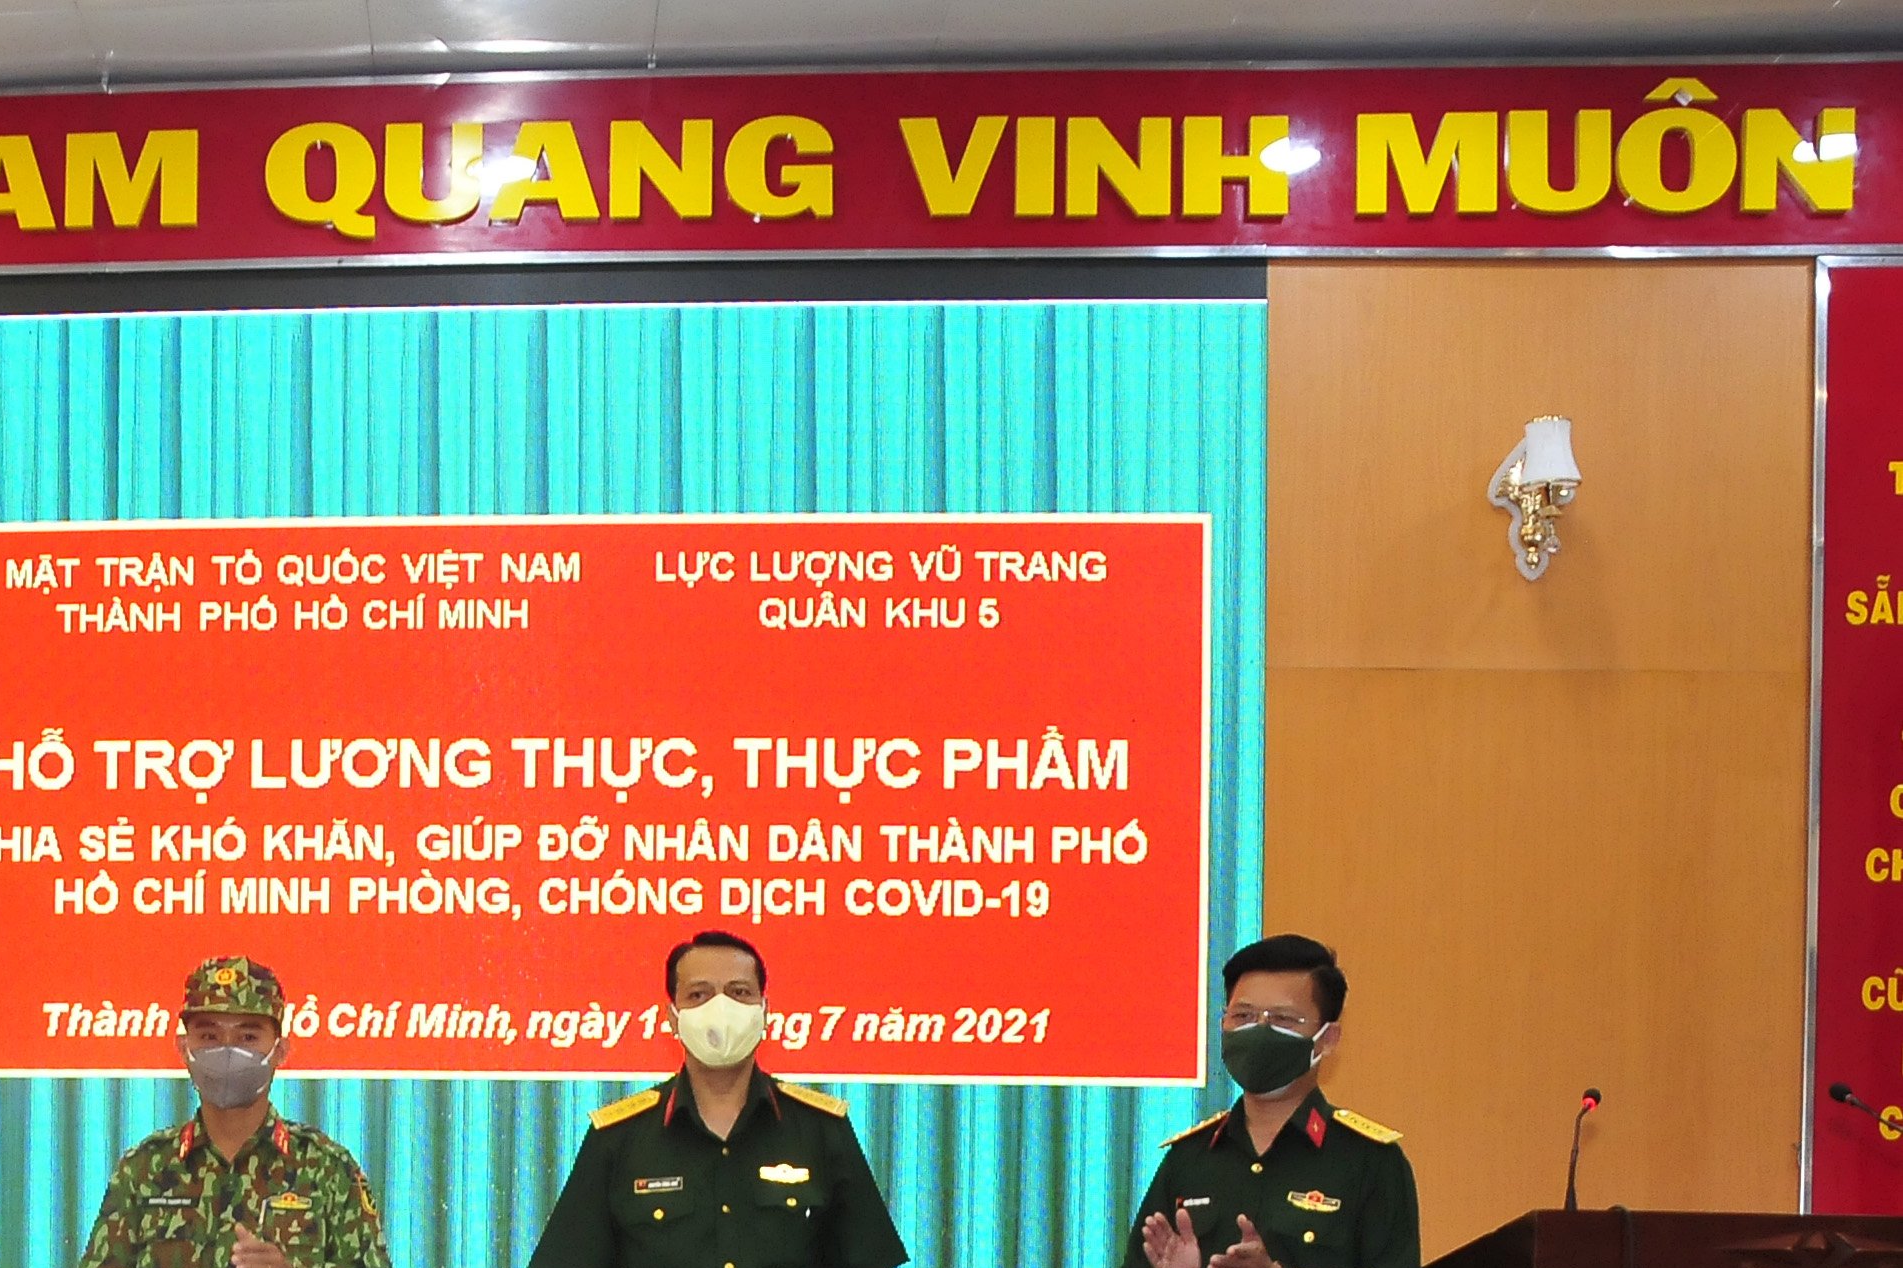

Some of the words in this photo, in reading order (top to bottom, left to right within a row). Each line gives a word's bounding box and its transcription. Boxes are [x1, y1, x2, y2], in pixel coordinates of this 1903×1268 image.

[264, 113, 835, 241] QUANG
[900, 113, 1293, 219] VINH
[1354, 76, 1856, 216] MUÔN
[6, 555, 80, 594] MẶT
[96, 553, 194, 592] TRẬN
[212, 549, 262, 585] TỔ
[277, 548, 385, 586] QUỐC
[402, 549, 483, 589] VIỆT
[502, 552, 580, 582] NAM
[656, 552, 734, 588] LỰC
[751, 551, 893, 587] LƯỢNG
[910, 545, 961, 581] VŨ
[975, 551, 1106, 581] TRANG
[56, 597, 180, 633] THÀNH
[200, 595, 277, 631] PHỐ
[295, 594, 347, 630] HỒ
[363, 593, 425, 629] CHÍ
[439, 599, 528, 629] MINH
[760, 591, 865, 630] QUÂN
[886, 598, 965, 628] KHU
[979, 599, 999, 628] 5
[94, 740, 234, 804] TRỢ
[251, 739, 491, 788] LƯƠNG
[511, 738, 713, 803] THỰC,
[734, 738, 920, 803] THỰC
[944, 726, 1128, 790] PHẨM
[80, 817, 134, 861] SẺ
[152, 817, 246, 861] KHÓ
[264, 818, 394, 867] KHĂN,
[417, 816, 521, 860] GIÚP
[537, 816, 609, 861] ĐỠ
[625, 818, 748, 861] NHÂN
[769, 819, 861, 861] DÂN
[880, 817, 1034, 863] THÀNH
[1052, 819, 1147, 864] PHỐ
[55, 870, 118, 914] HỒ
[134, 869, 206, 914] CHÍ
[221, 878, 329, 913] MINH
[349, 869, 521, 920] PHÒNG,
[539, 869, 702, 914] CHÓNG
[721, 878, 824, 924] DỊCH
[845, 879, 1049, 917] COVID-19
[41, 1003, 169, 1038] Thành
[328, 1002, 402, 1038] Chí
[406, 1003, 517, 1045] Minh,
[526, 1002, 630, 1048] ngày
[818, 1007, 846, 1041] 7
[852, 1004, 946, 1042] năm
[952, 1008, 1050, 1044] 2021
